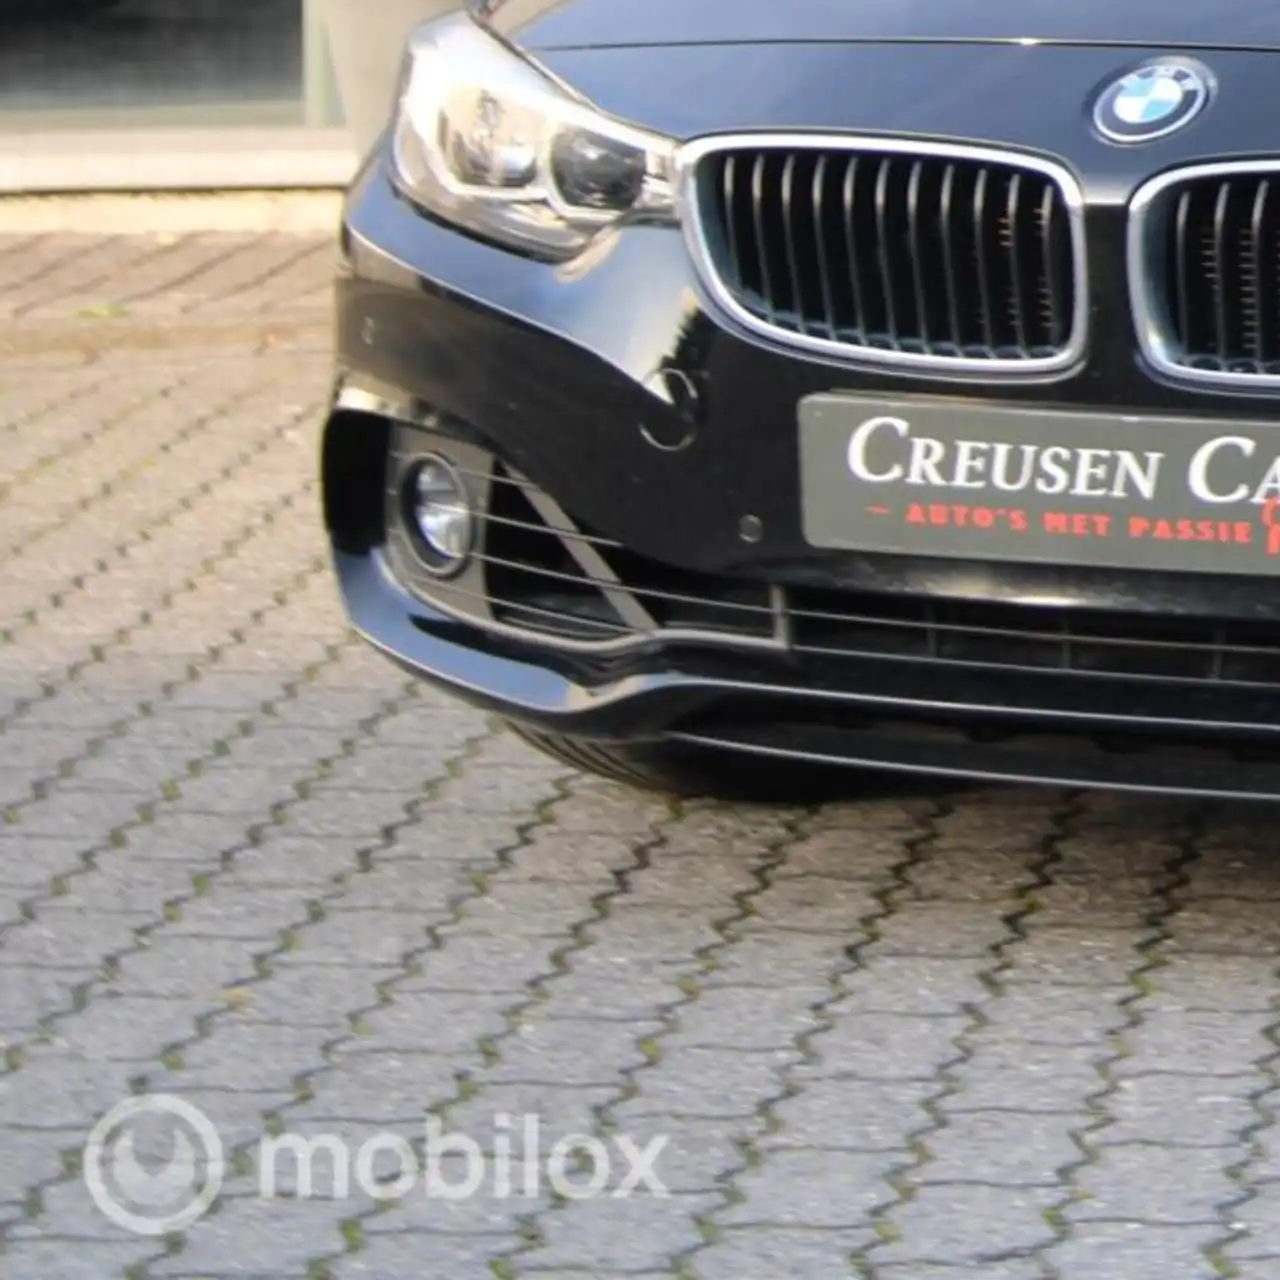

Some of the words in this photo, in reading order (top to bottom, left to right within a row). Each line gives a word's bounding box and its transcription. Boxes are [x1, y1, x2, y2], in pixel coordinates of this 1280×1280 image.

[847, 415, 1166, 500] CREUSEN
[904, 502, 1028, 532] AUTO'S
[1042, 511, 1111, 537] MET
[1127, 515, 1252, 544] PASSIE
